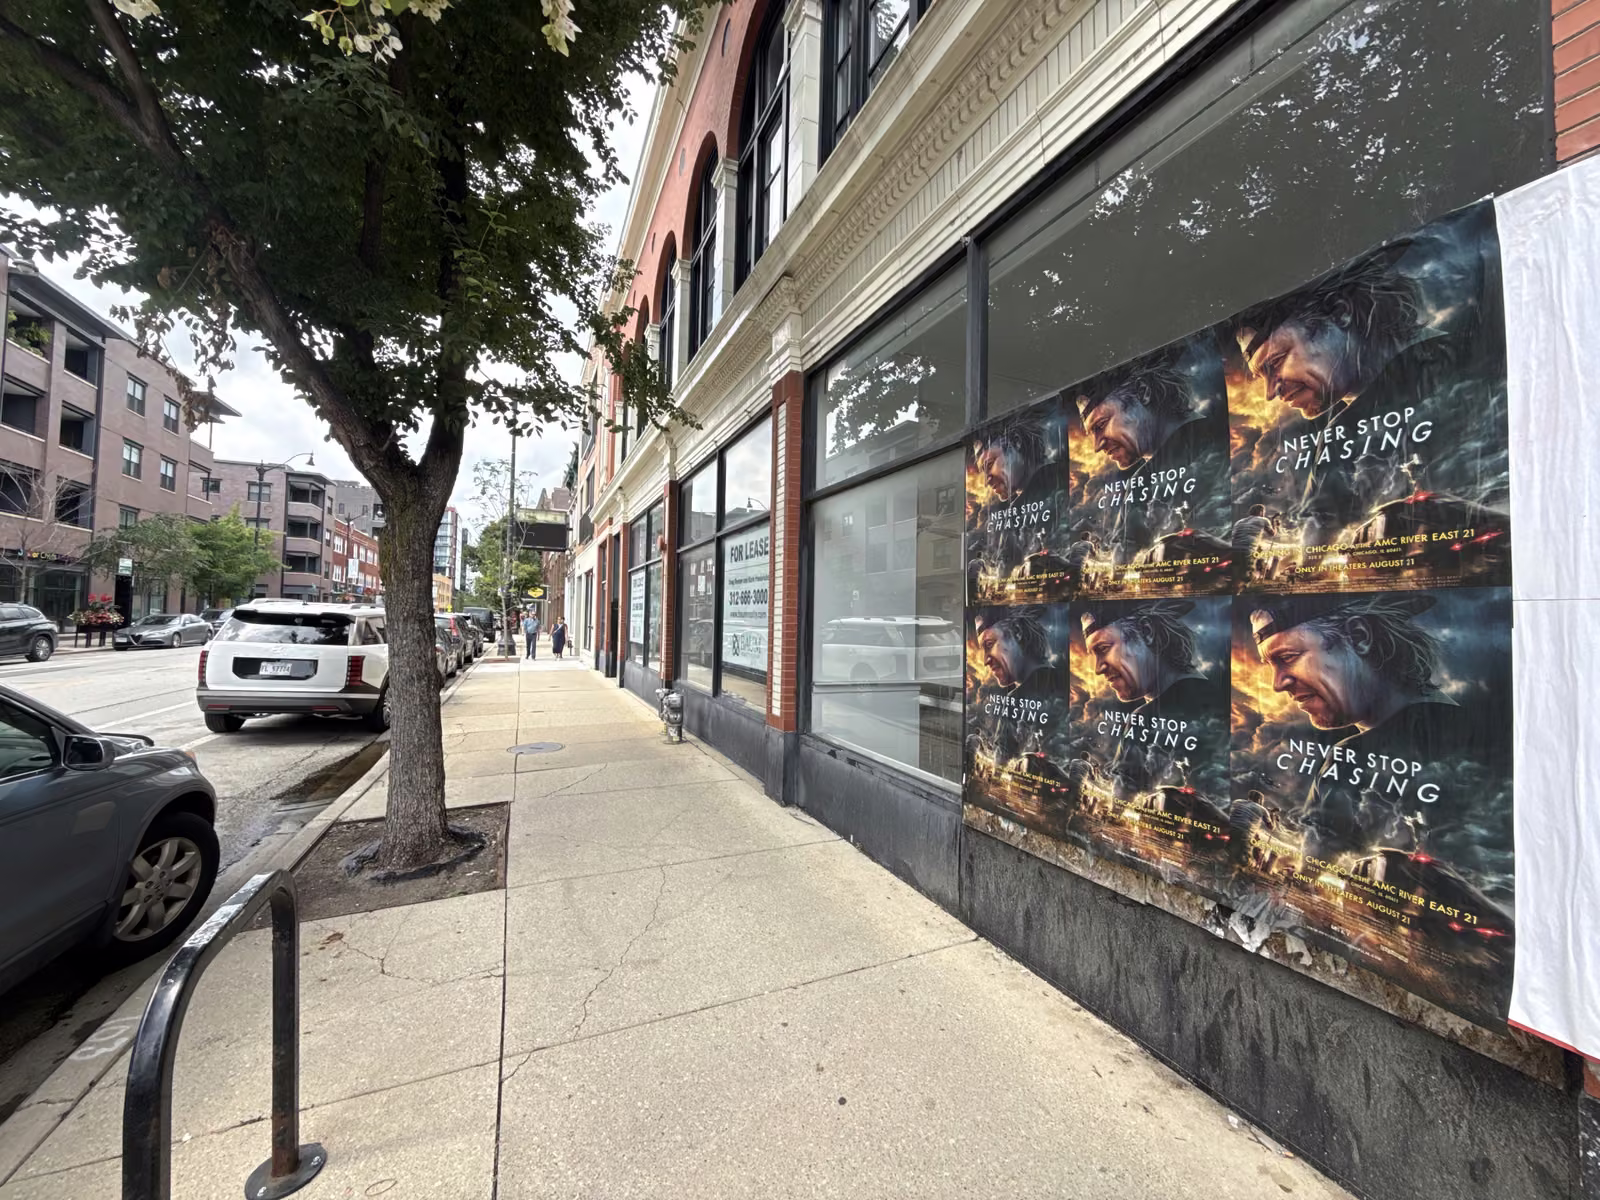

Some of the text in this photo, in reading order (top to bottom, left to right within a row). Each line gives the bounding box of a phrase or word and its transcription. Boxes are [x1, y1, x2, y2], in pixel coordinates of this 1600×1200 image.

[1283, 407, 1416, 453] NEVER STOP
[1275, 421, 1433, 474] CHASING
[1098, 478, 1196, 509] CHASING
[1104, 466, 1187, 494] NEVER STOP
[986, 510, 1051, 532] CHASING
[991, 500, 1044, 521] NEVER STOP
[730, 536, 769, 563] FOR LEASE
[1305, 542, 1348, 554] CHICAGO
[1374, 537, 1397, 547] AMC
[1400, 534, 1428, 544] RIVER
[1432, 530, 1459, 541] EAST
[1463, 528, 1475, 538] 21
[1193, 557, 1209, 565] EAST
[1295, 566, 1316, 574] ONLY
[1329, 562, 1366, 571] THEATERS
[1369, 559, 1404, 569] AUGUST
[1406, 558, 1415, 566] 21
[984, 703, 1049, 724] CHASING
[989, 694, 1042, 710] NEVER STOP
[1104, 710, 1188, 733] NEVER STOP
[1097, 721, 1198, 750] CHASING
[1290, 738, 1422, 777] NEVER STOP
[1276, 753, 1441, 803] CHASING
[1157, 810, 1172, 820] AMC
[1174, 815, 1192, 826] RIVER
[1193, 820, 1211, 831] EAST
[1212, 825, 1220, 834] 21
[1292, 872, 1313, 883] ONLY
[1327, 884, 1363, 904] THEATERS
[1366, 900, 1401, 919] AUGUST
[1402, 914, 1410, 925] 21
[1305, 855, 1347, 875] CHICAGO
[1372, 880, 1397, 895] AMC
[1398, 889, 1425, 907] RIVER
[1429, 900, 1460, 918] EAST
[1463, 912, 1478, 925] 21
